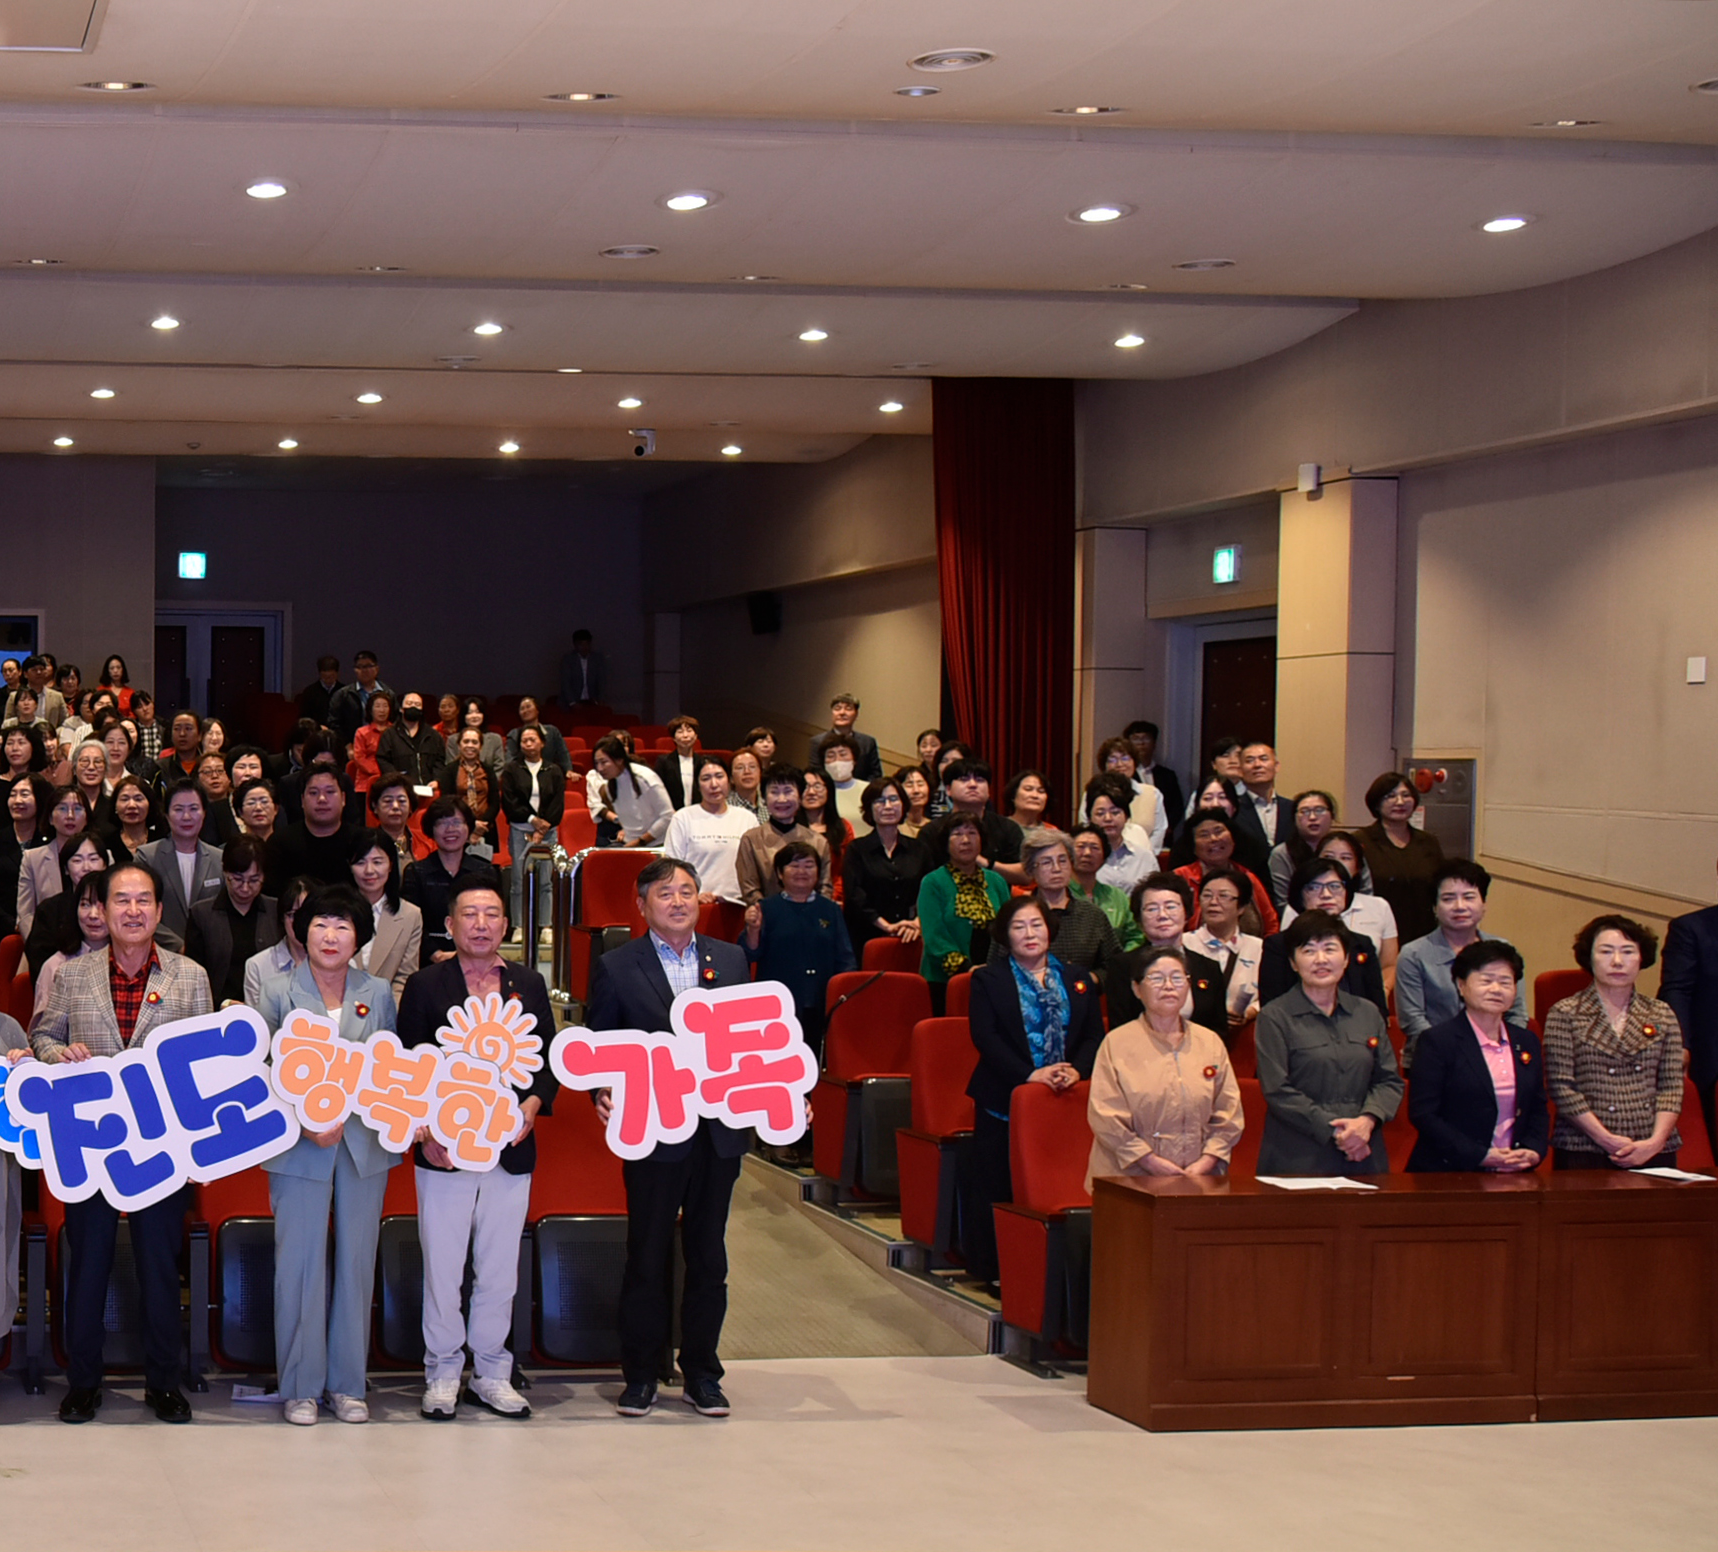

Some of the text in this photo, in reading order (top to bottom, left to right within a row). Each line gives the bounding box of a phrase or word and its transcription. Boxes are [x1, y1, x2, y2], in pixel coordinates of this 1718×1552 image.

[19, 1019, 288, 1198] 진도
[280, 1017, 517, 1163] 행복한
[562, 993, 807, 1147] 가족
